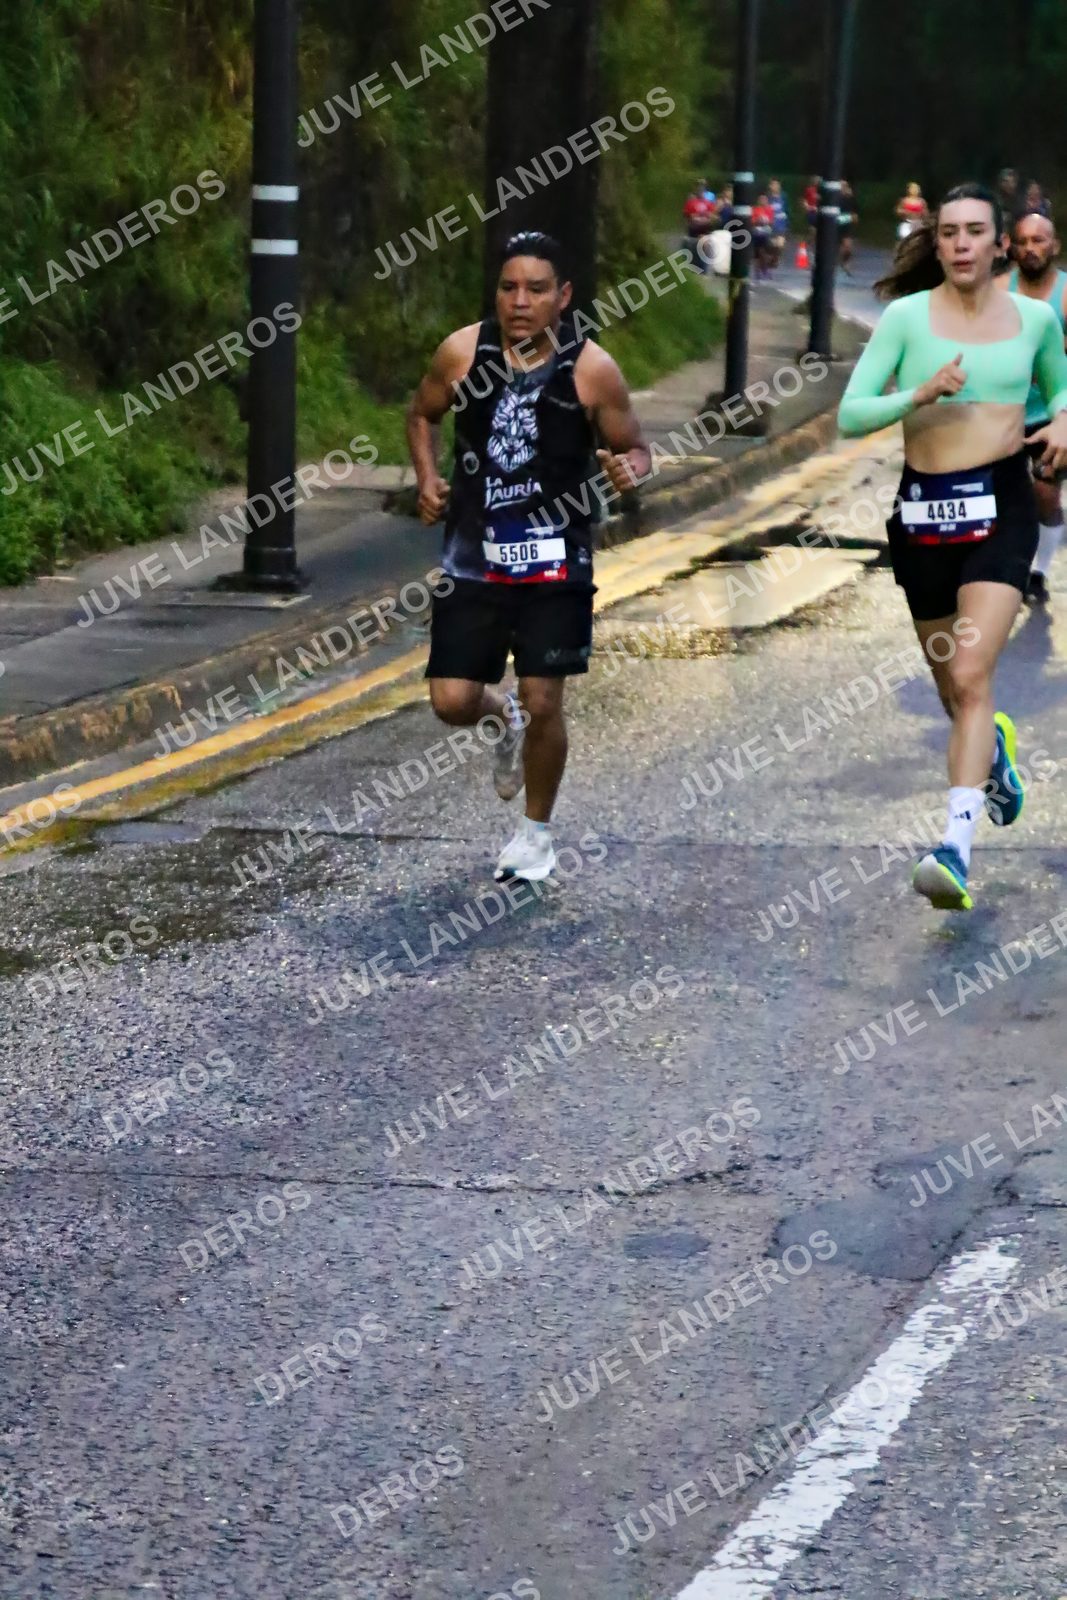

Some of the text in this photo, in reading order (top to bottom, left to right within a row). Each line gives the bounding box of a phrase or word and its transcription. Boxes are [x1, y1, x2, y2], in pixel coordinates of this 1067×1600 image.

[486, 476, 502, 488] LA
[927, 500, 967, 521] 4434
[499, 543, 539, 562] 5506
